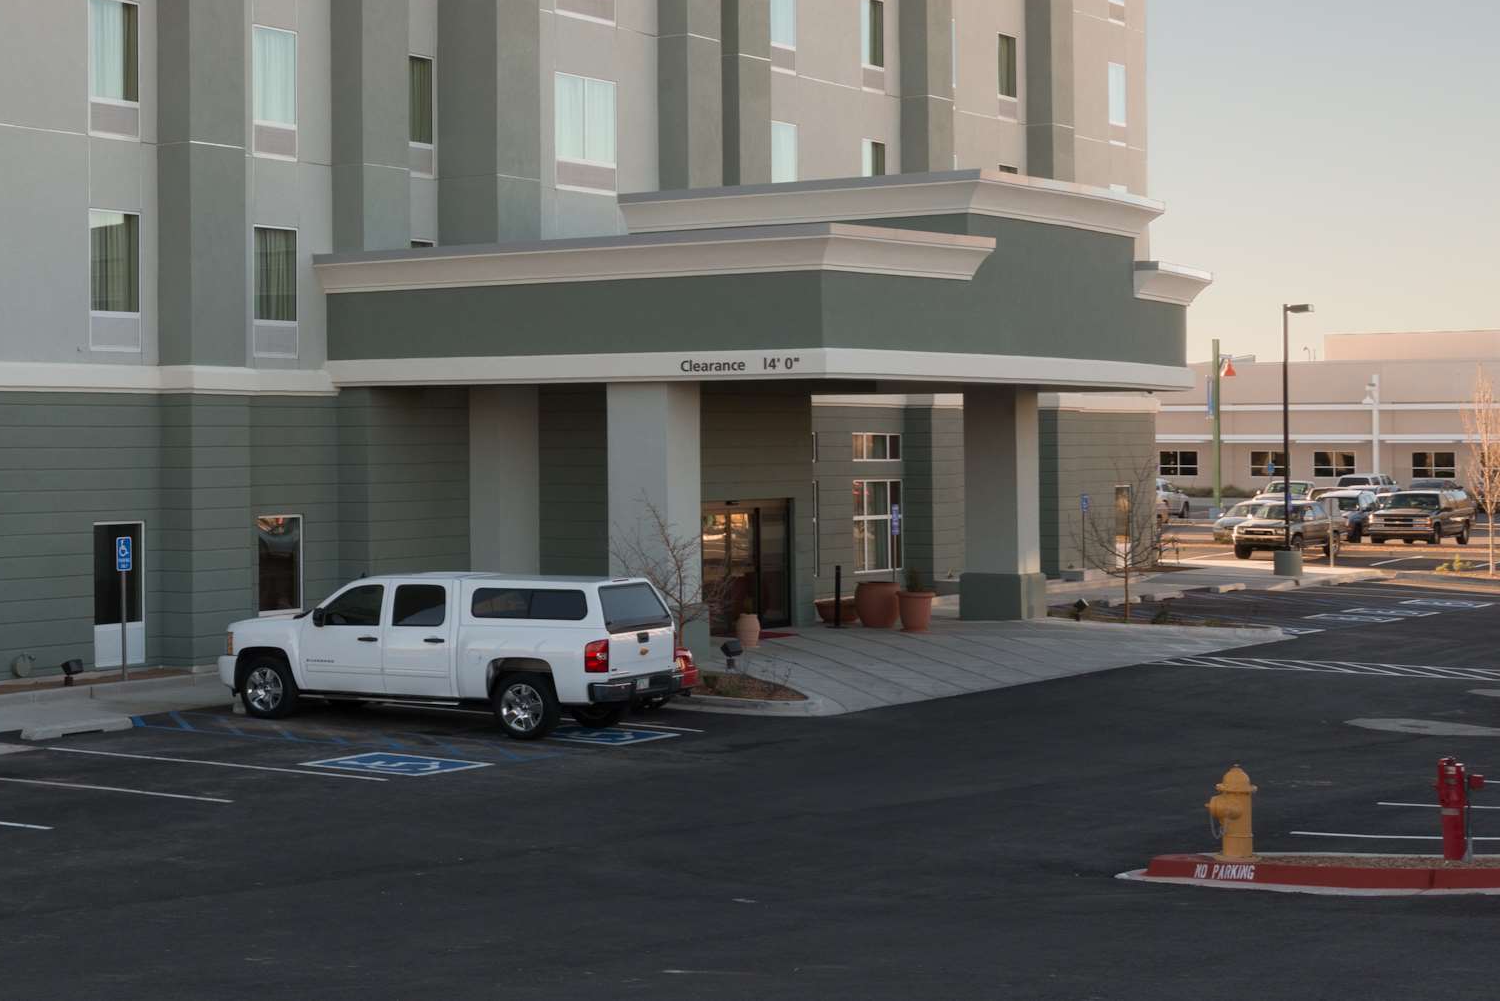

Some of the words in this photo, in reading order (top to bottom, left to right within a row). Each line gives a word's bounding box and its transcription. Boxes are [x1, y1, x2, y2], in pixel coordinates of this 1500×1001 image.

[680, 359, 746, 373] Clearance
[763, 357, 781, 370] 14'
[1194, 863, 1209, 879] NO
[1211, 864, 1256, 880] PARKING
